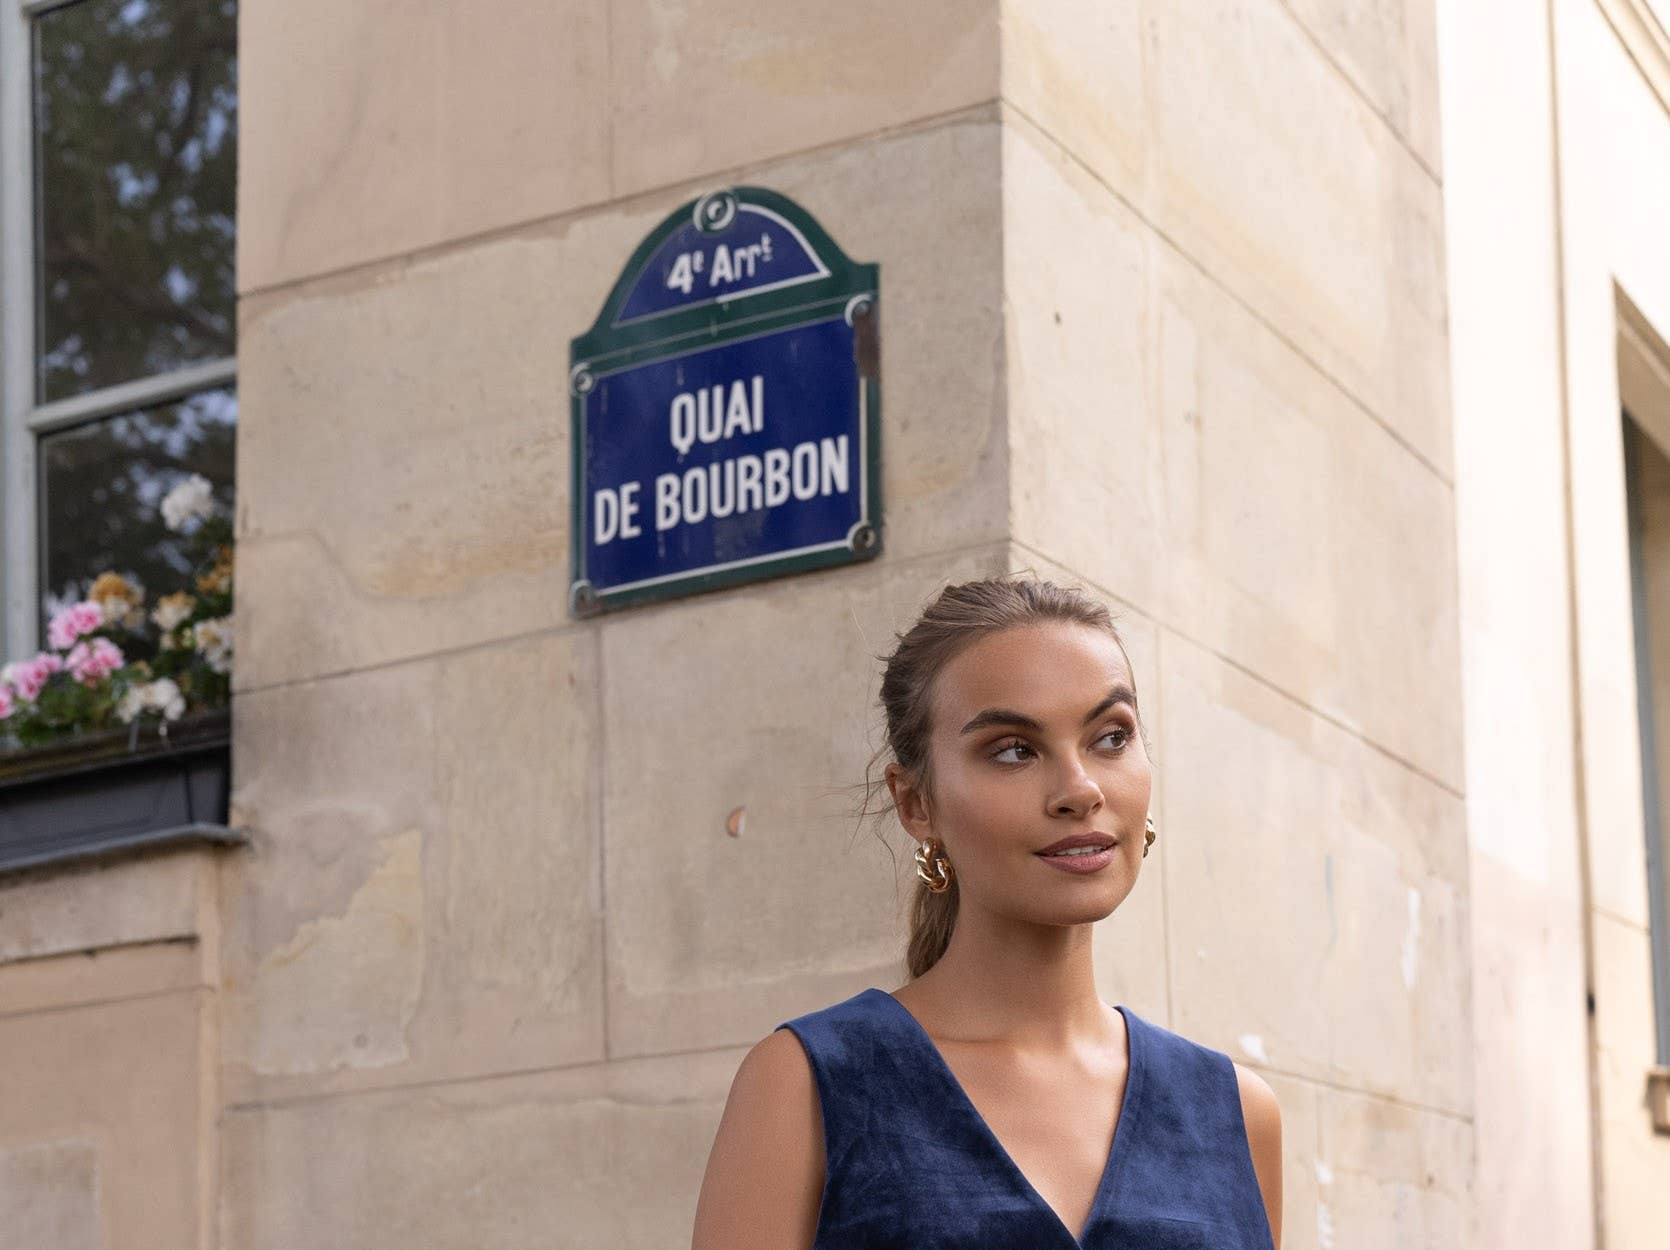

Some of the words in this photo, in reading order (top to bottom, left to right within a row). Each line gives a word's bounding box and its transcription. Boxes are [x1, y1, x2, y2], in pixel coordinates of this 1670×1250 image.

[669, 376, 764, 455] QUAI
[594, 482, 641, 545] DE
[655, 435, 849, 532] BOURBON
